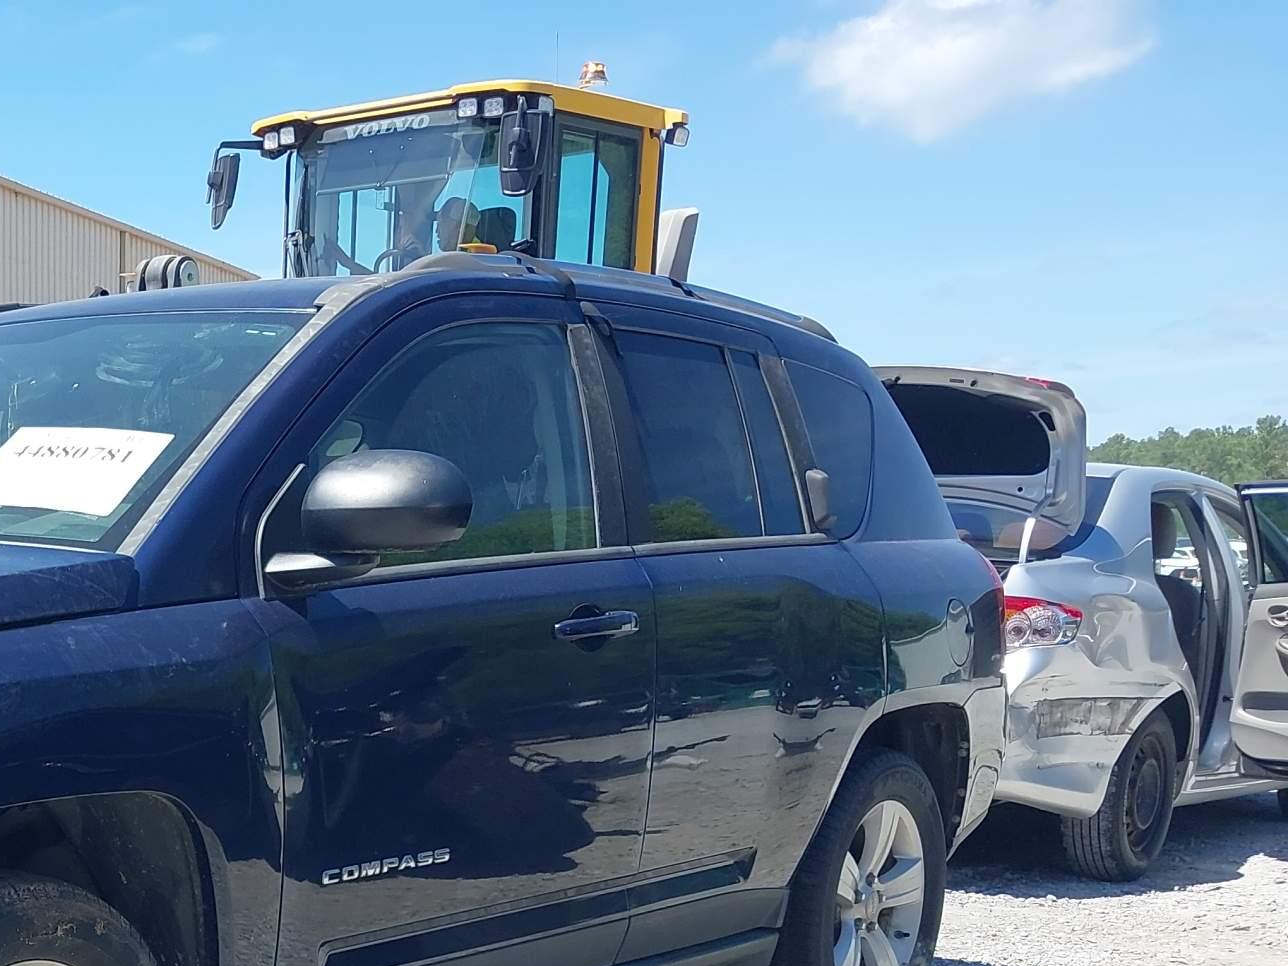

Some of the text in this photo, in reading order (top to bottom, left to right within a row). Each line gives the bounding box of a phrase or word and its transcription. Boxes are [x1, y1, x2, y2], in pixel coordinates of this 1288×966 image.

[344, 115, 430, 140] VOLVO
[13, 444, 134, 463] 44880781
[321, 847, 451, 885] COMPASS
